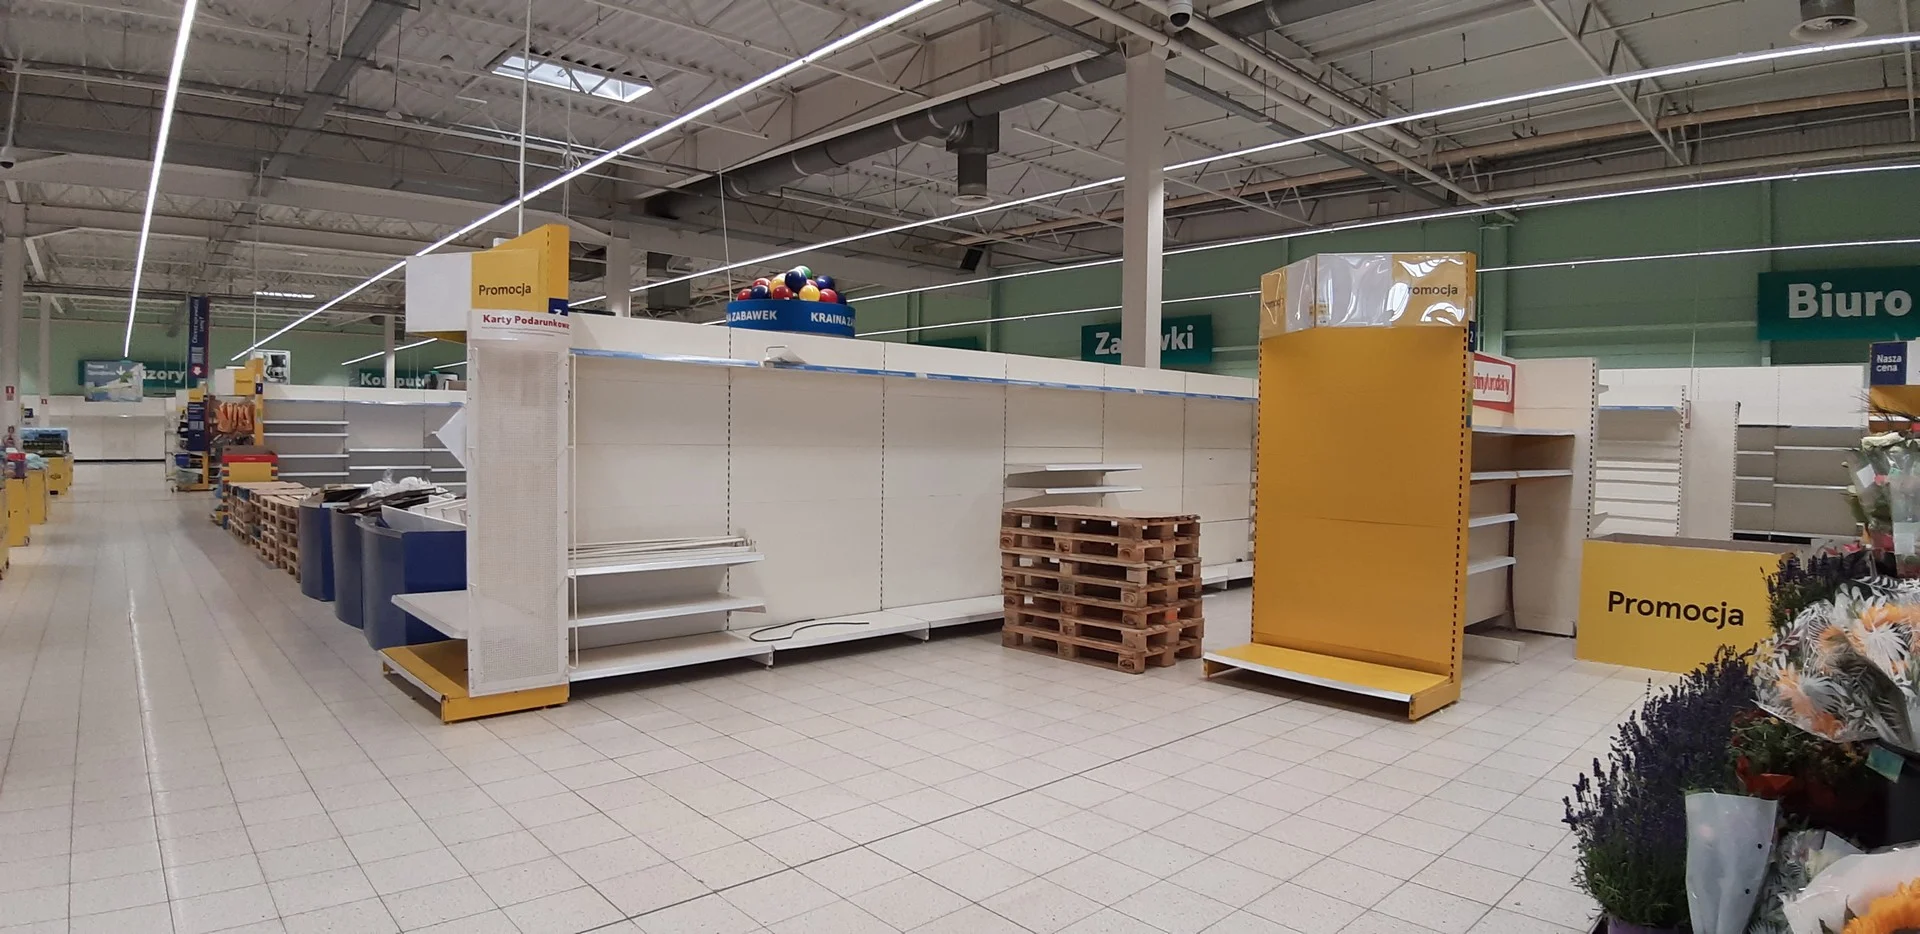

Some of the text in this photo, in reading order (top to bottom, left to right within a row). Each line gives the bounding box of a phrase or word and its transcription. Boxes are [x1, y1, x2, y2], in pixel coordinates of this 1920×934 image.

[479, 283, 532, 297] Promocja
[1406, 284, 1458, 297] romocja
[1787, 281, 1913, 319] Biuro
[482, 314, 570, 329] Karty Podarunkowe
[731, 310, 778, 322] ZABAWEK
[810, 312, 847, 326] KRAINA
[1469, 331, 1474, 343] 2
[1876, 354, 1902, 363] Nasza
[1876, 364, 1898, 372] cena
[1607, 590, 1745, 630] Promocja
